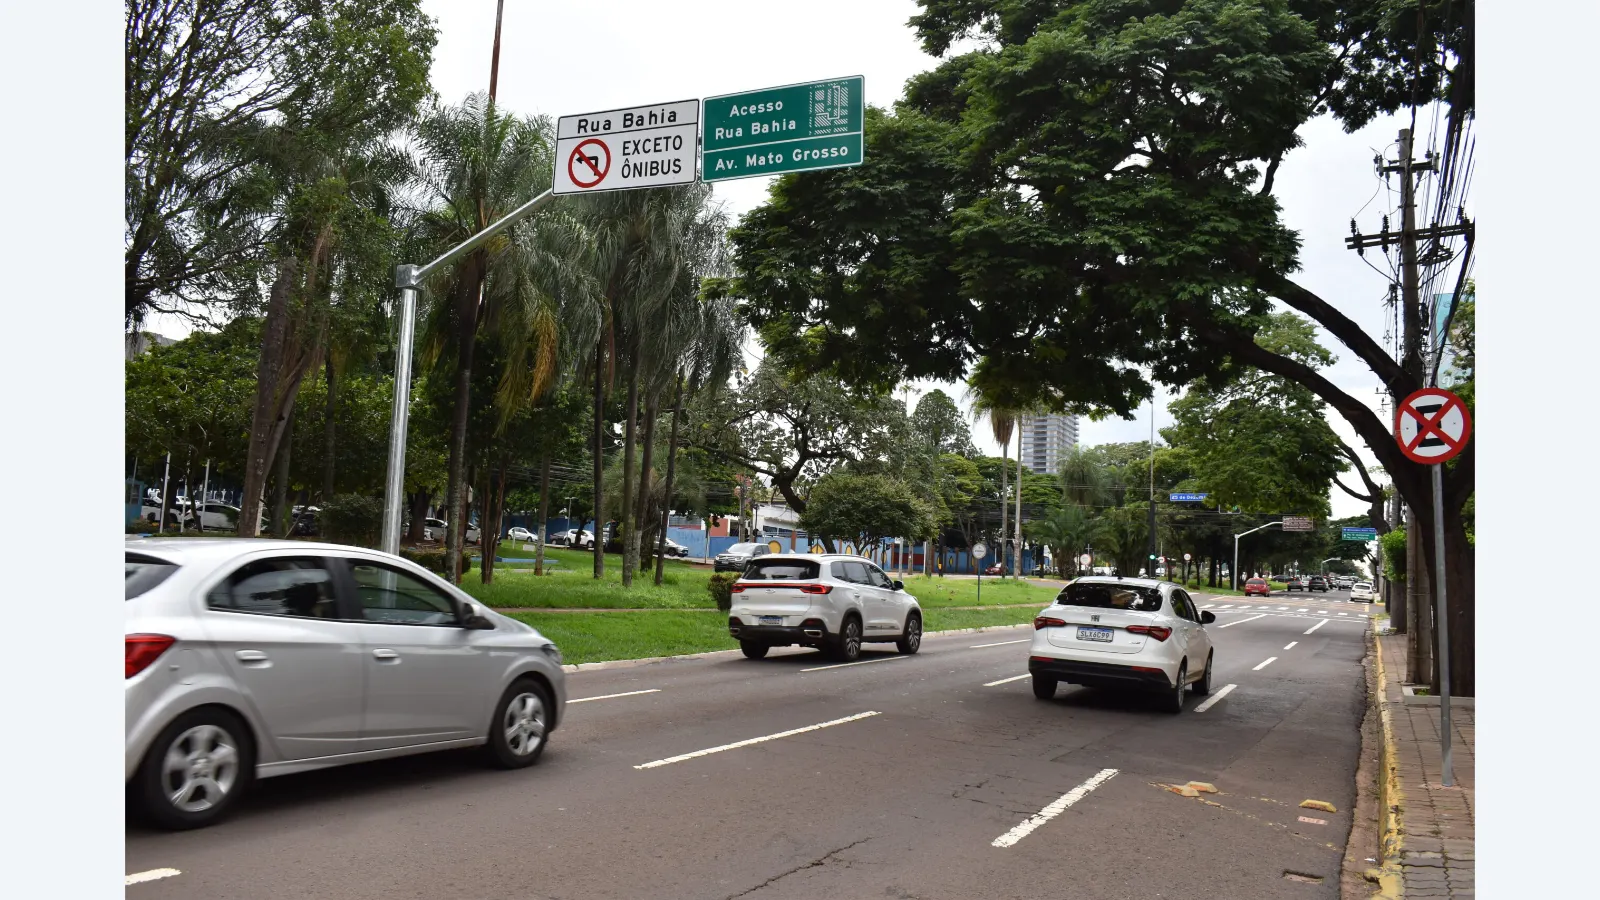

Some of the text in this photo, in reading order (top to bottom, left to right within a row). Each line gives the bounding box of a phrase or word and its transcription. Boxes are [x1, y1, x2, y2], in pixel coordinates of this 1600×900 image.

[729, 101, 783, 117] Acesso
[577, 108, 677, 134] Rua Bahia
[715, 119, 796, 140] Rua Bahia
[622, 135, 682, 156] EXCETO
[621, 158, 682, 179] ÔNIBUS
[715, 146, 849, 171] Av. Mato Grosso
[1080, 630, 1110, 639] SLX6C99
